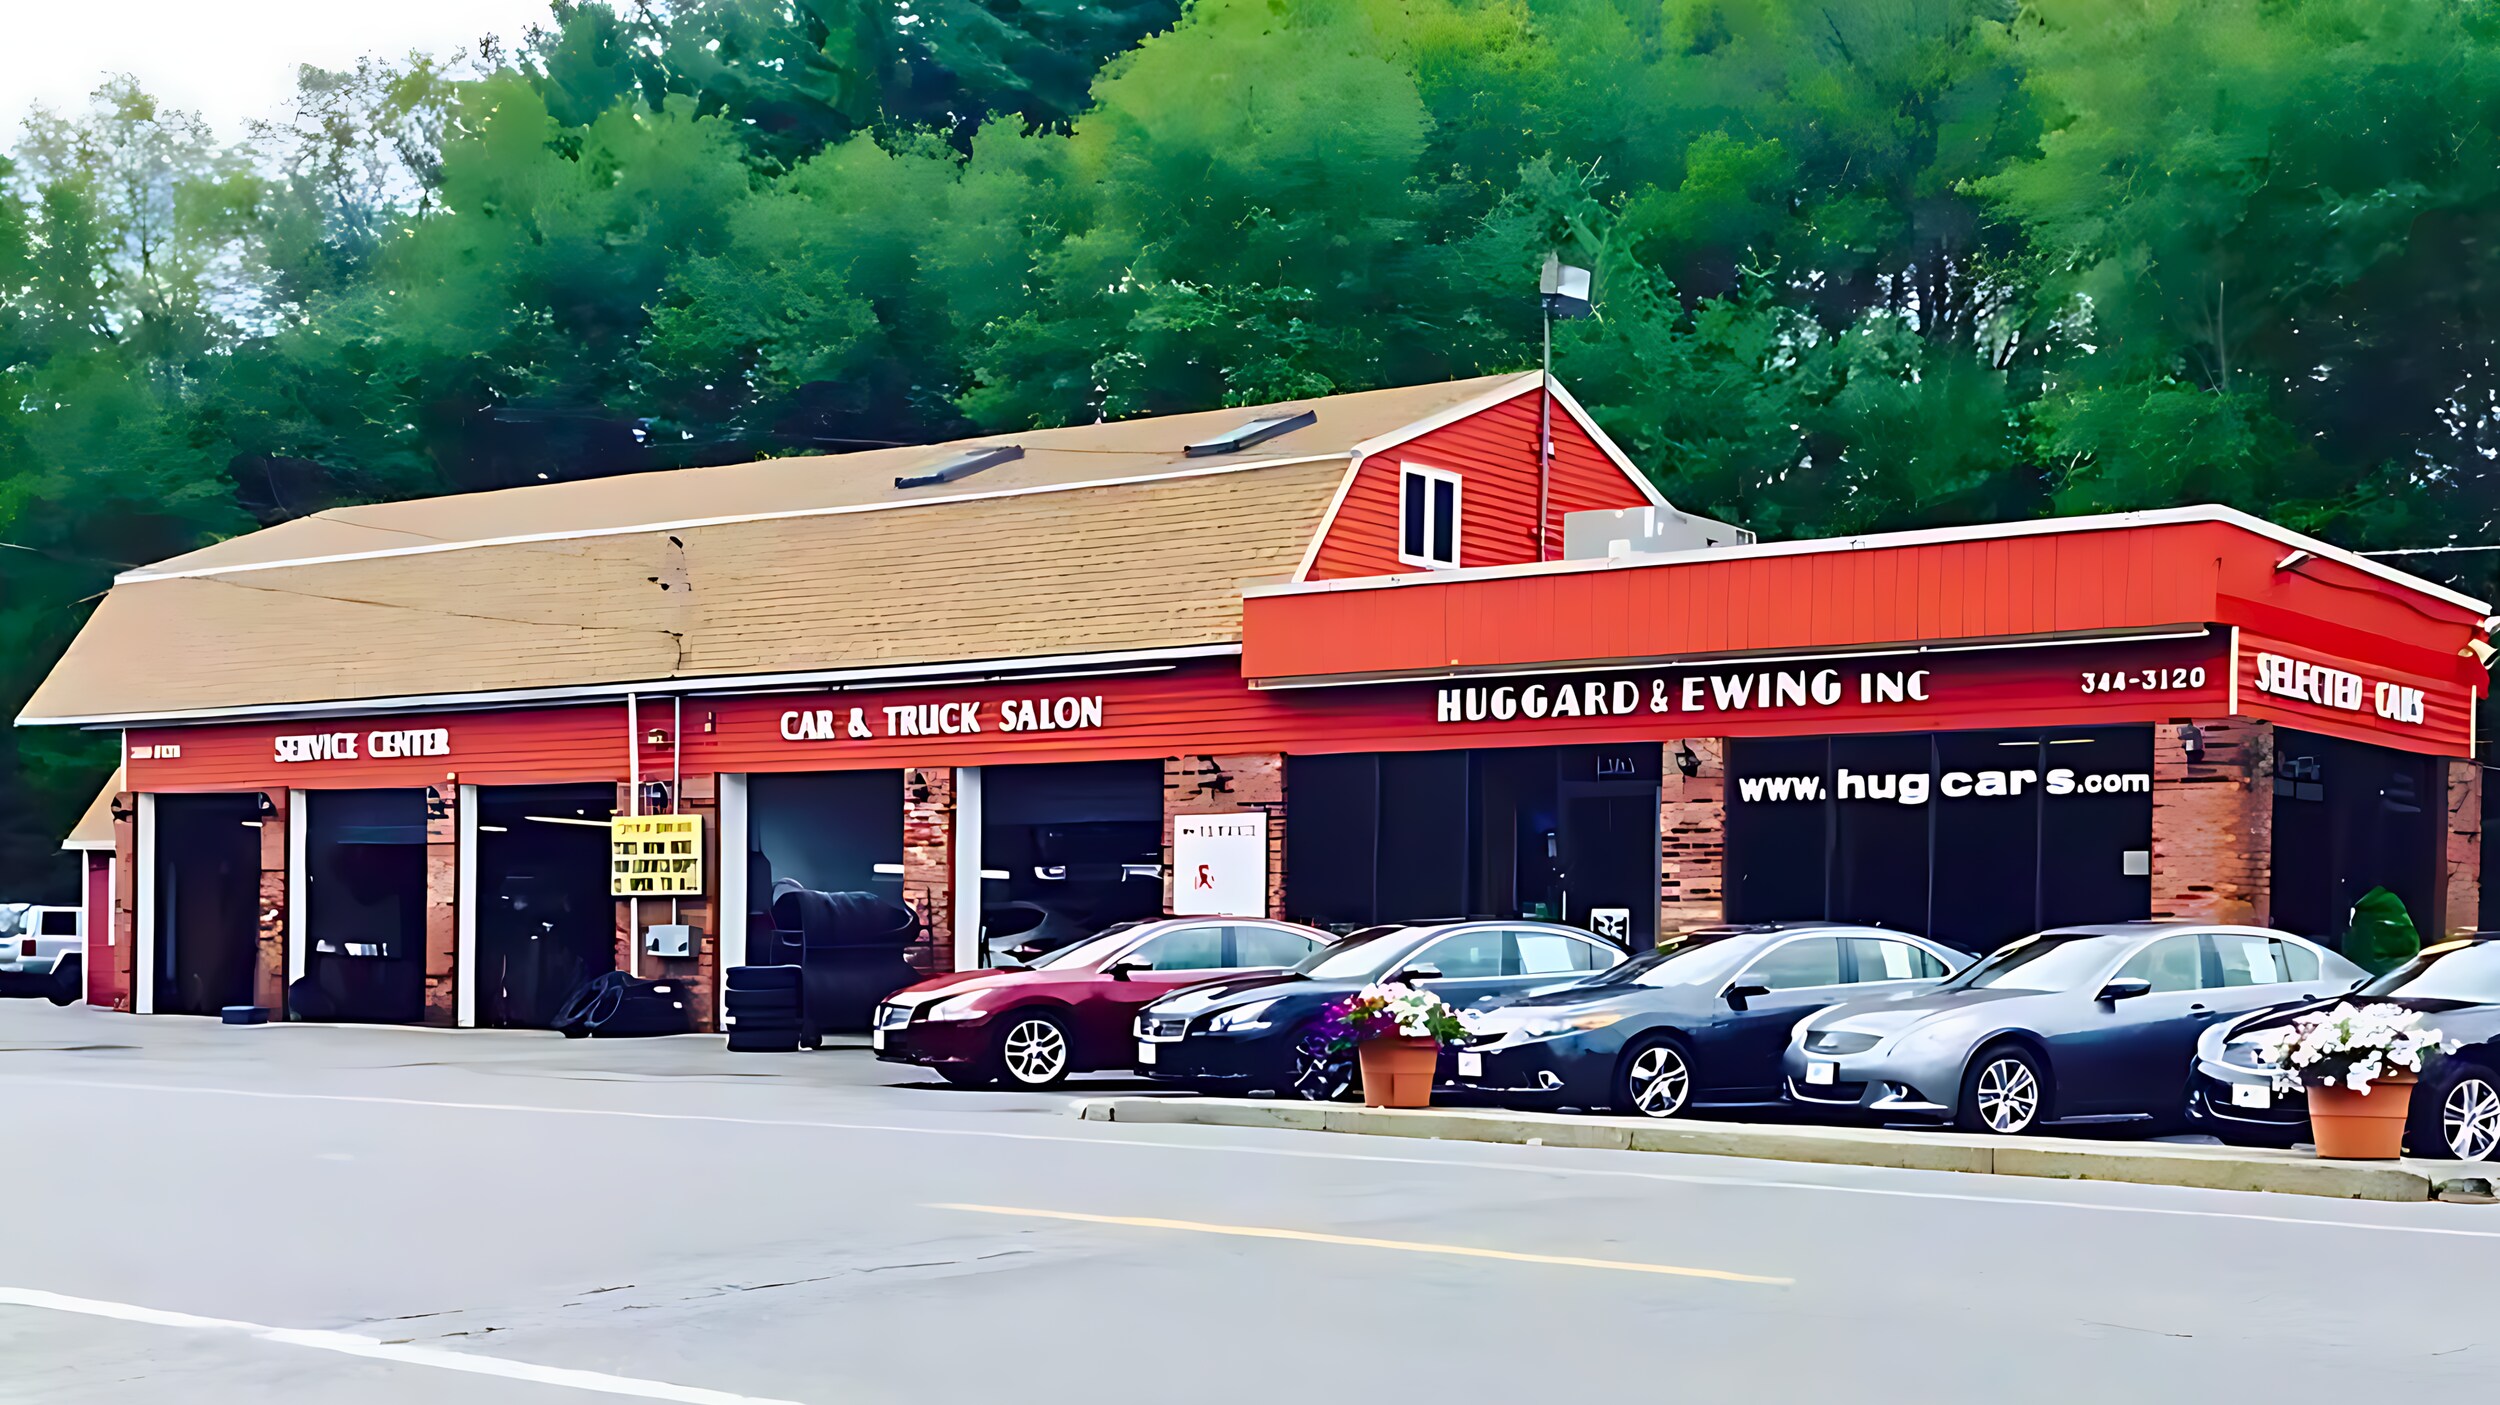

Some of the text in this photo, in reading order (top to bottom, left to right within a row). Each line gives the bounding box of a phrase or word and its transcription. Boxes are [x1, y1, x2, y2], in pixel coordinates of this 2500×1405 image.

[1436, 668, 1931, 722] HUGGARD & EWING INC
[2080, 666, 2207, 694] 344-3120
[2254, 651, 2426, 725] SELECTED CARS
[780, 695, 1104, 740] CAR & TRUCK SALON
[274, 727, 451, 763] SERVICE CENTER
